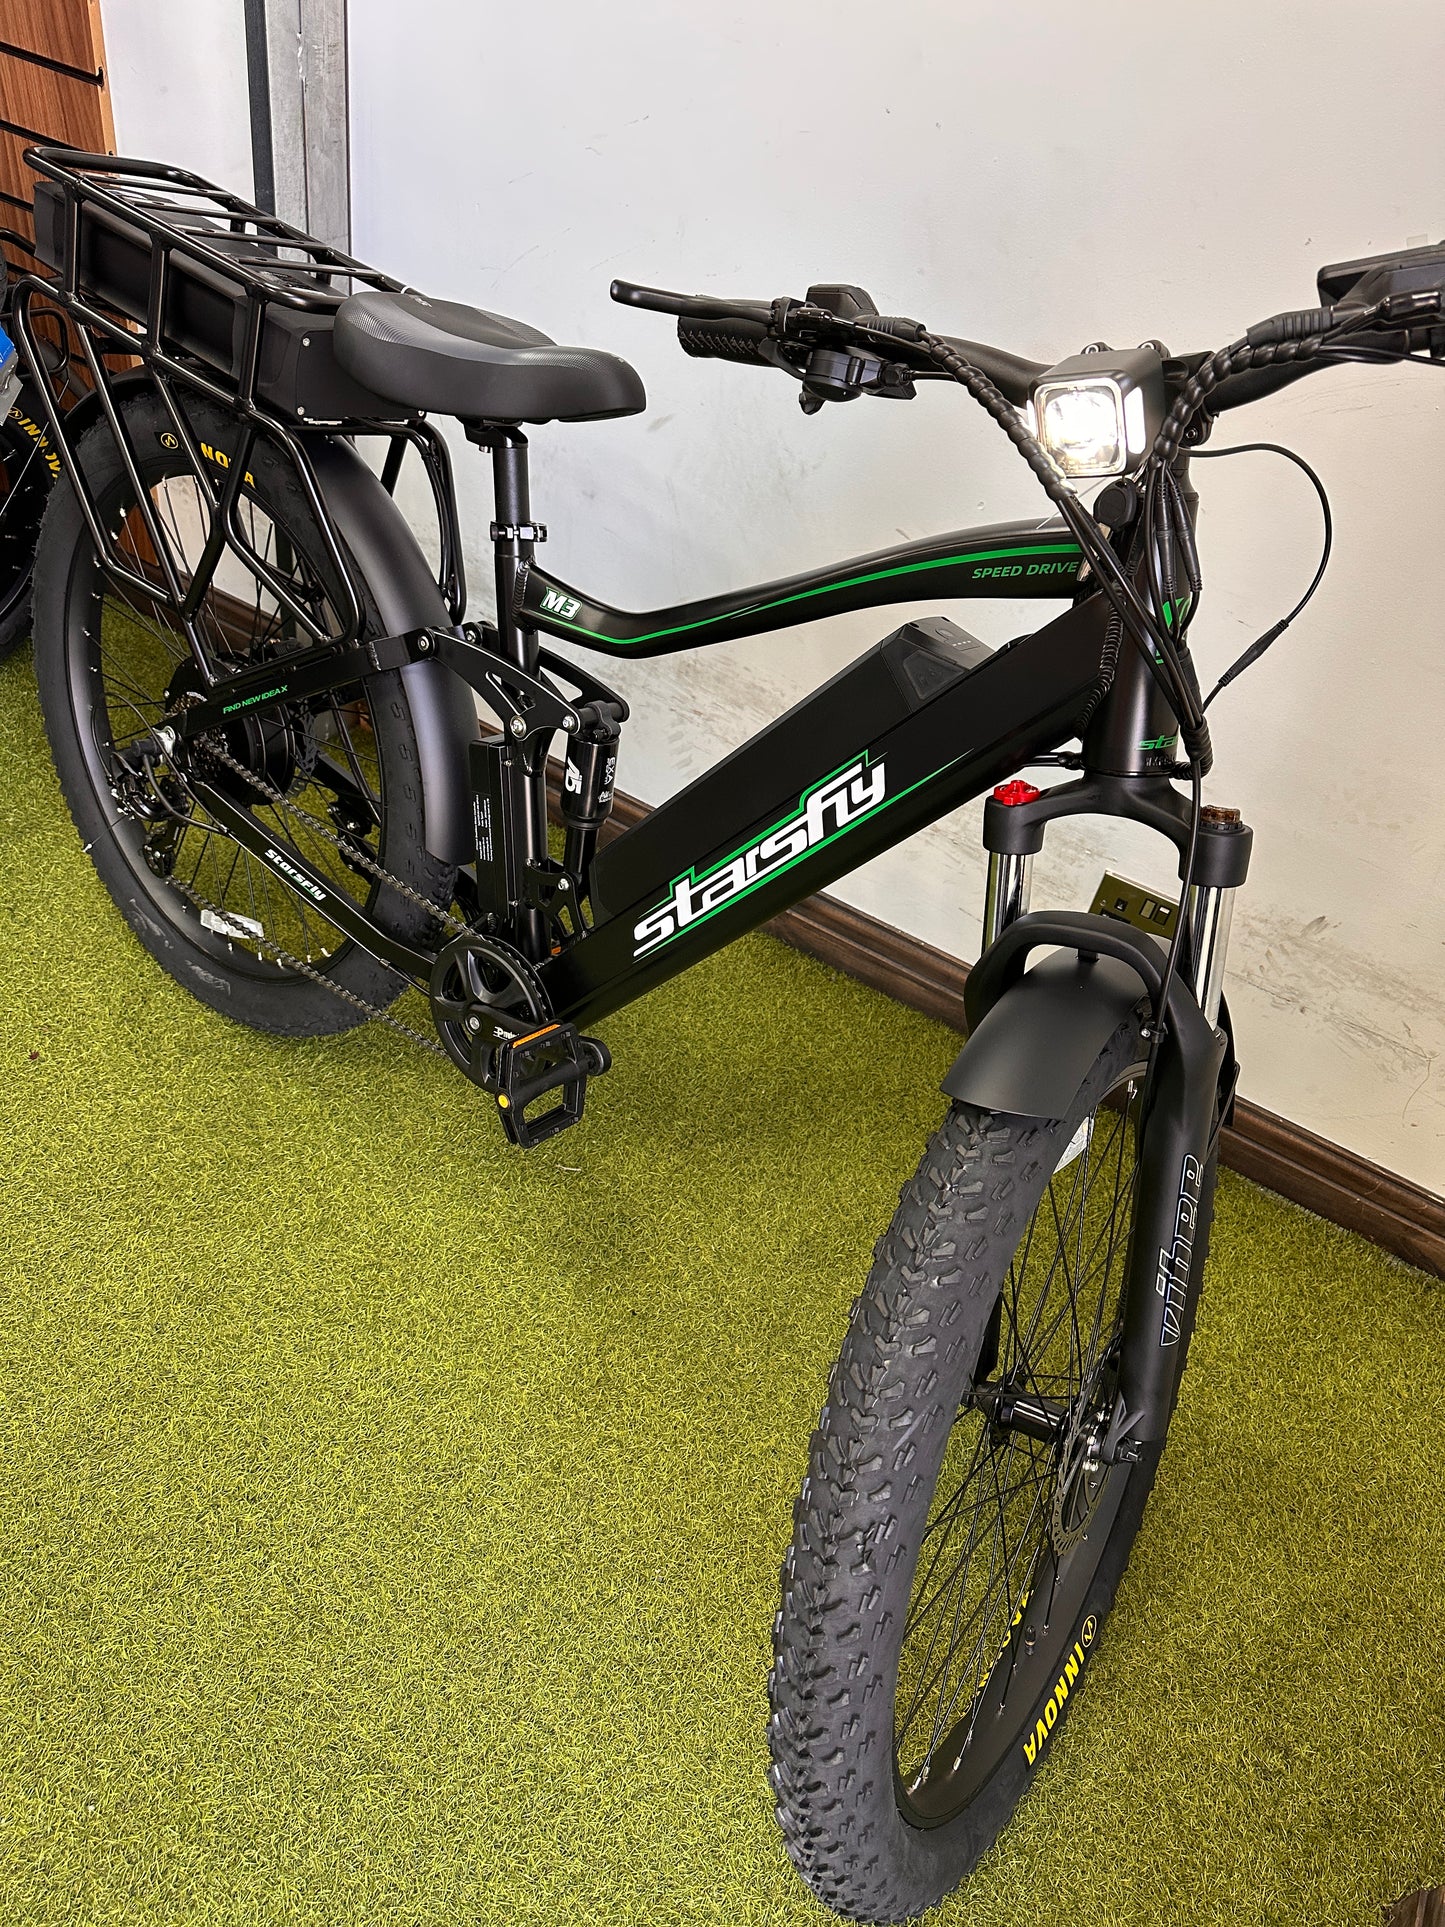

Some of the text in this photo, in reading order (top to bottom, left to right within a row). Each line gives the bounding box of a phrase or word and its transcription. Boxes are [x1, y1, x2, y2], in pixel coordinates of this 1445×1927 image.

[971, 561, 1078, 579] SPEED DRIVE
[541, 588, 581, 620] M3
[223, 702, 241, 714] FIND
[242, 695, 261, 707] NEW
[265, 848, 327, 902] starsfly
[633, 762, 886, 957] starsfly
[1023, 1641, 1086, 1766] INNOVA
